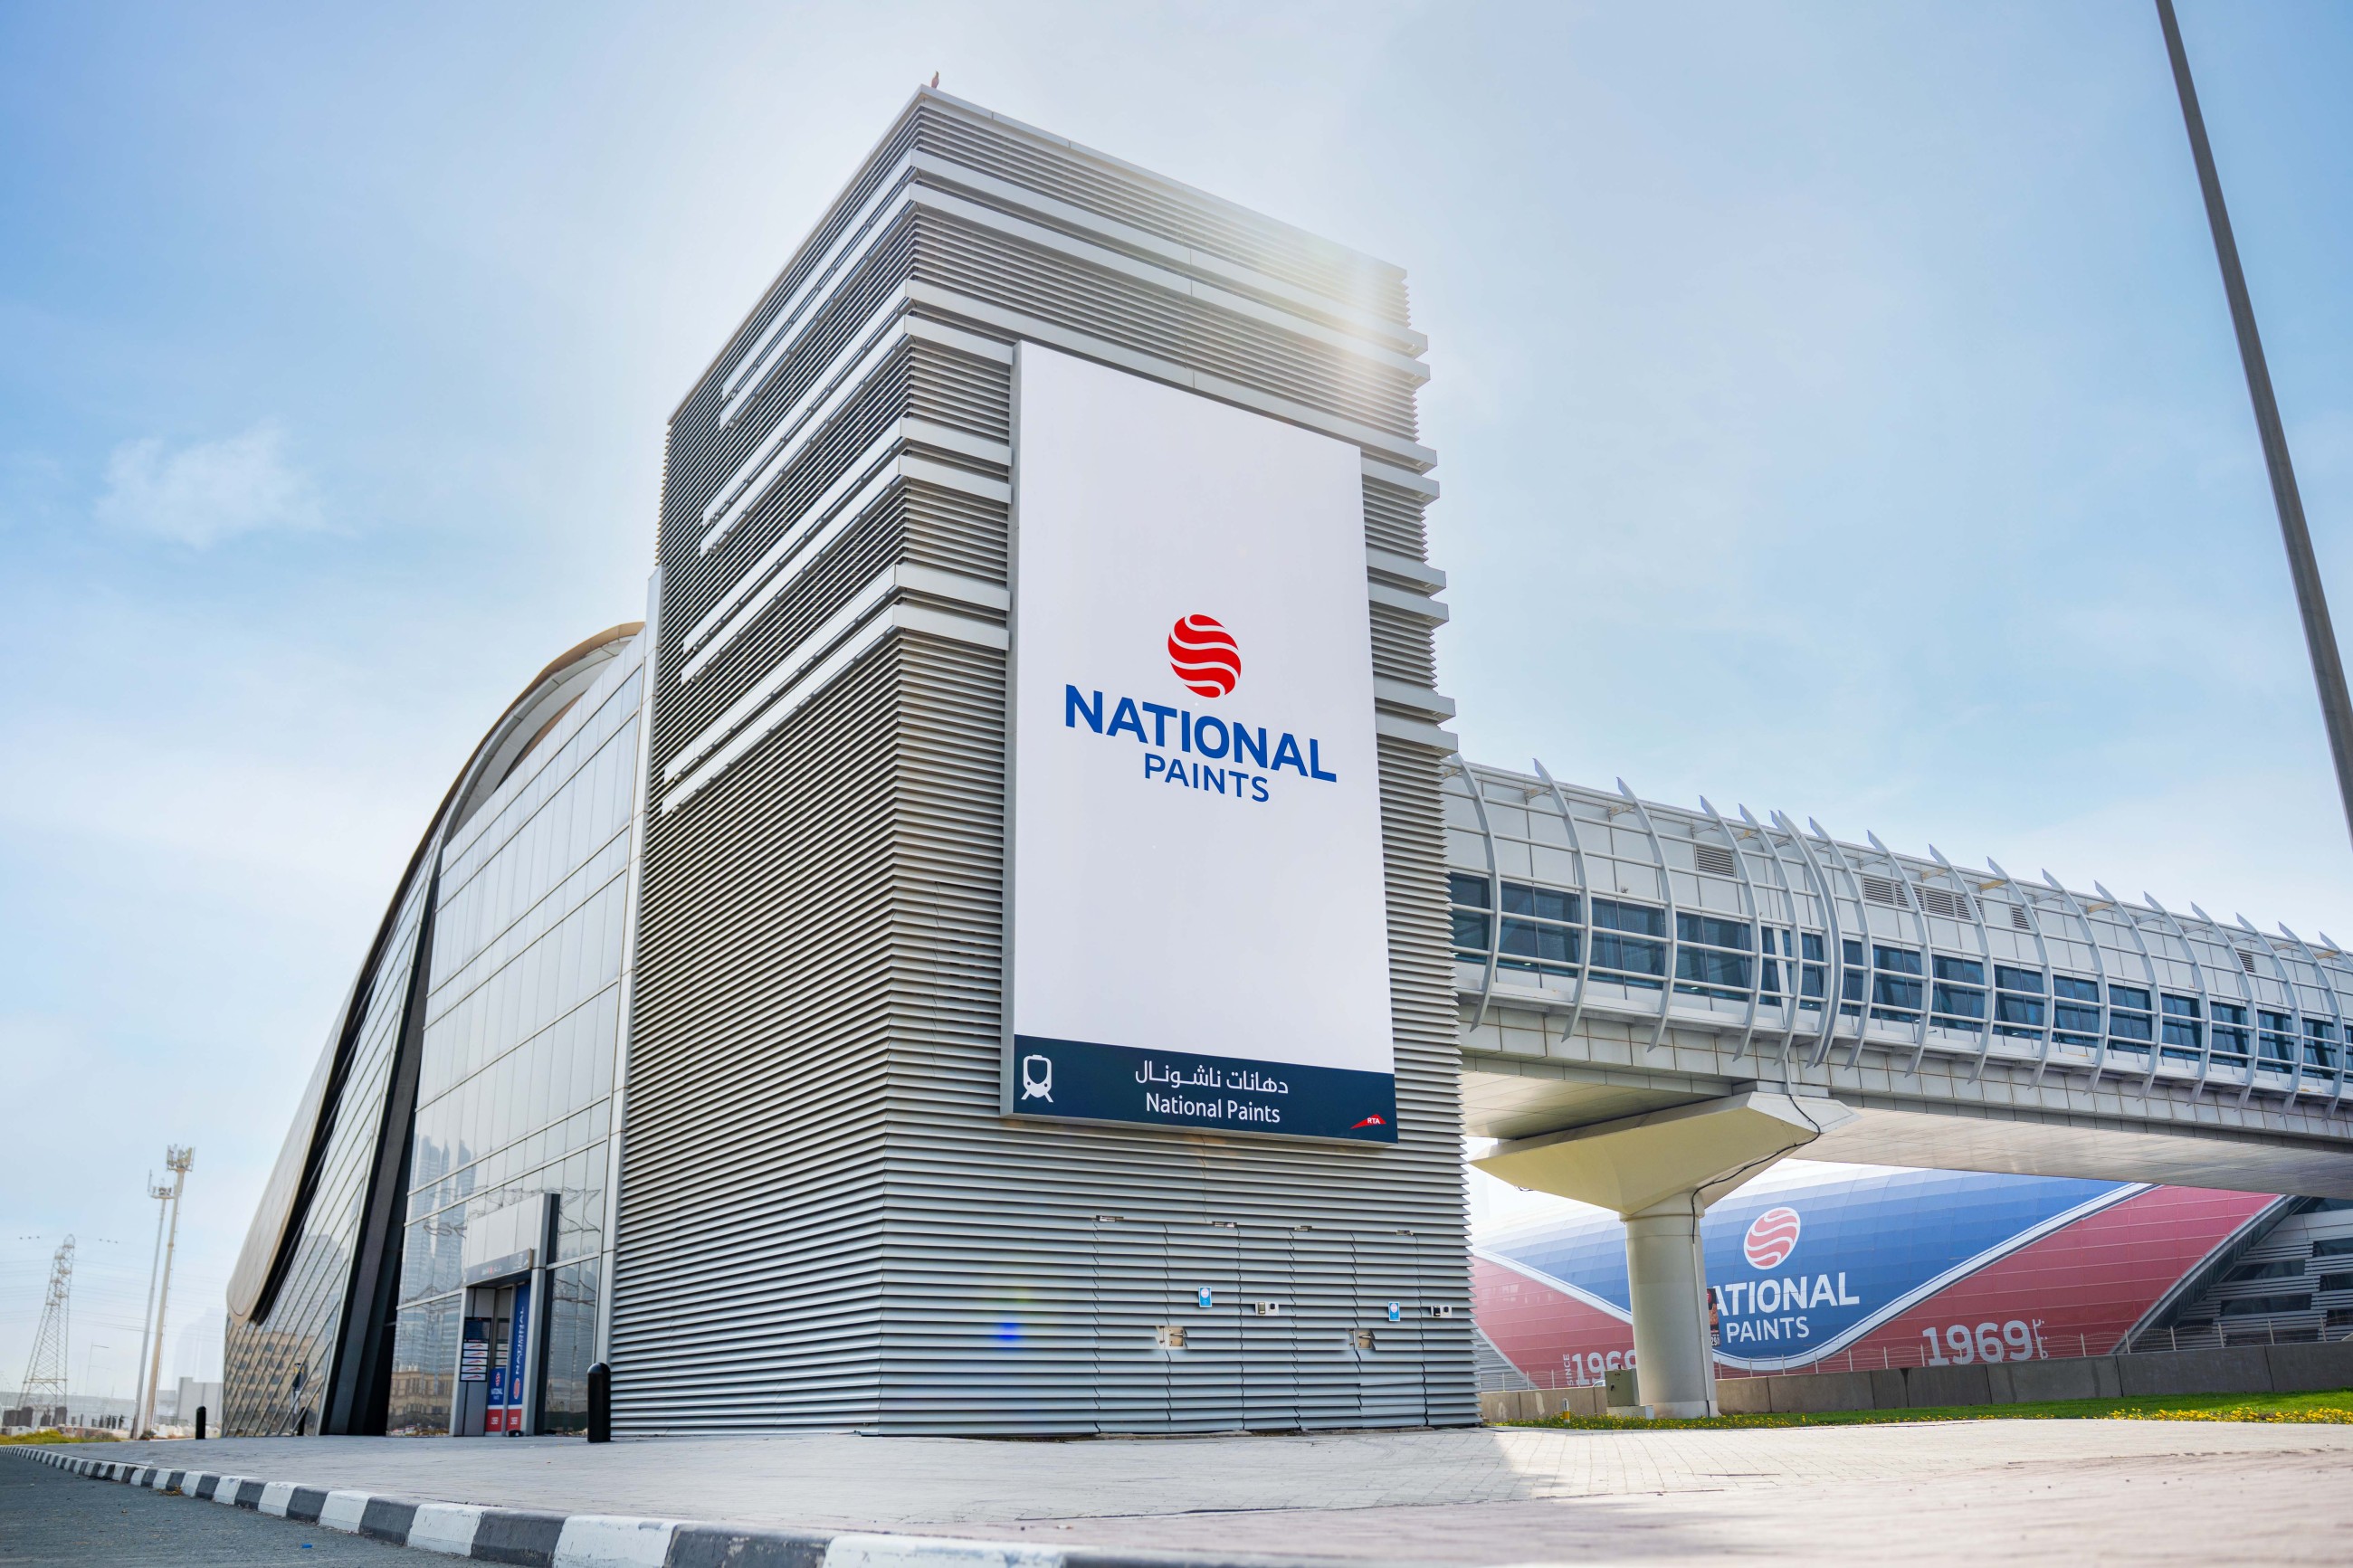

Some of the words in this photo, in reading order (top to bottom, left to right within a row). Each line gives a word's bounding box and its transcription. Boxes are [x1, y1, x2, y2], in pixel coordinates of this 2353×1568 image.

[1066, 683, 1337, 783] NATIONAL
[1145, 753, 1270, 803] PAINTS
[1135, 1060, 1221, 1088] ناشونال
[1226, 1069, 1289, 1094] دهانات
[1146, 1092, 1222, 1118] National
[1227, 1099, 1281, 1124] Paints
[1367, 1117, 1381, 1125] RTA
[1713, 1271, 1861, 1316] ATIONAL
[1726, 1316, 1810, 1344] PAINTS
[1922, 1320, 2034, 1366] 1969
[1563, 1354, 1574, 1386] SINCE
